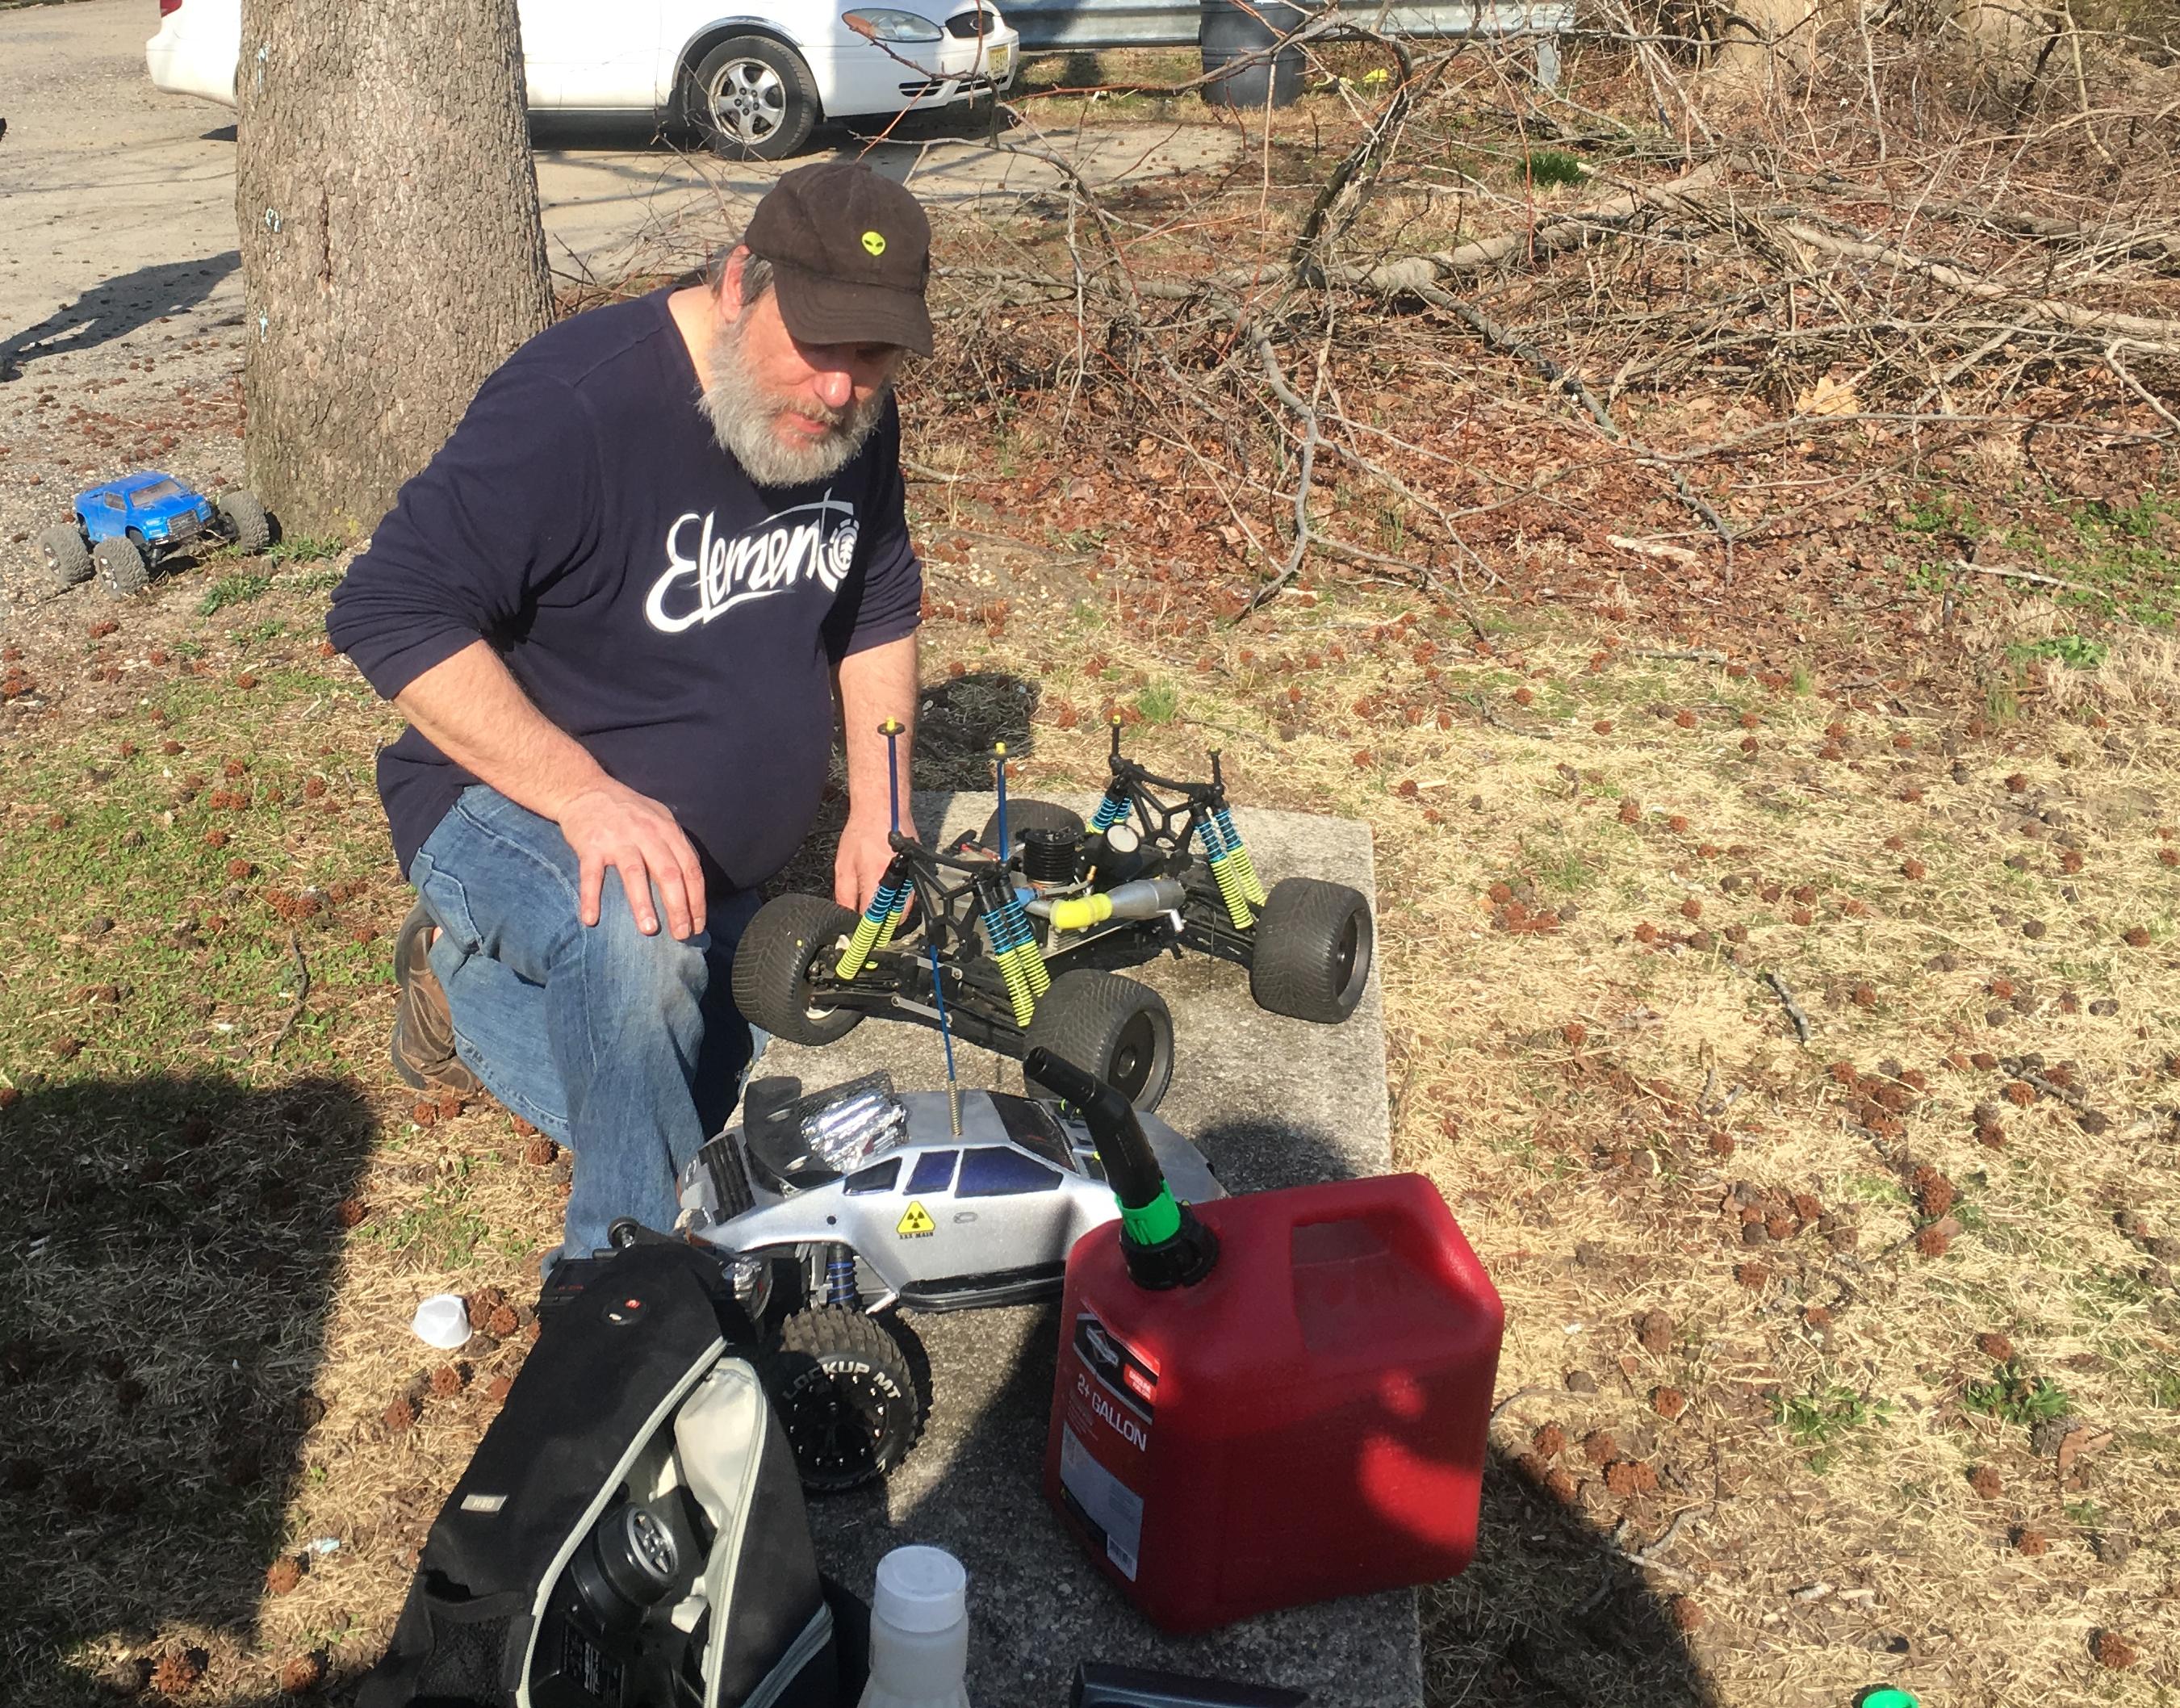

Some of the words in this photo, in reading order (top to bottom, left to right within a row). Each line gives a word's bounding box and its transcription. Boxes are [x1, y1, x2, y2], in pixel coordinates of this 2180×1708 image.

[645, 488, 855, 633] Element
[782, 1360, 870, 1400] LOCKUP
[872, 1371, 902, 1399] MT
[1077, 1372, 1090, 1398] 2+
[1091, 1392, 1147, 1452] GALLON
